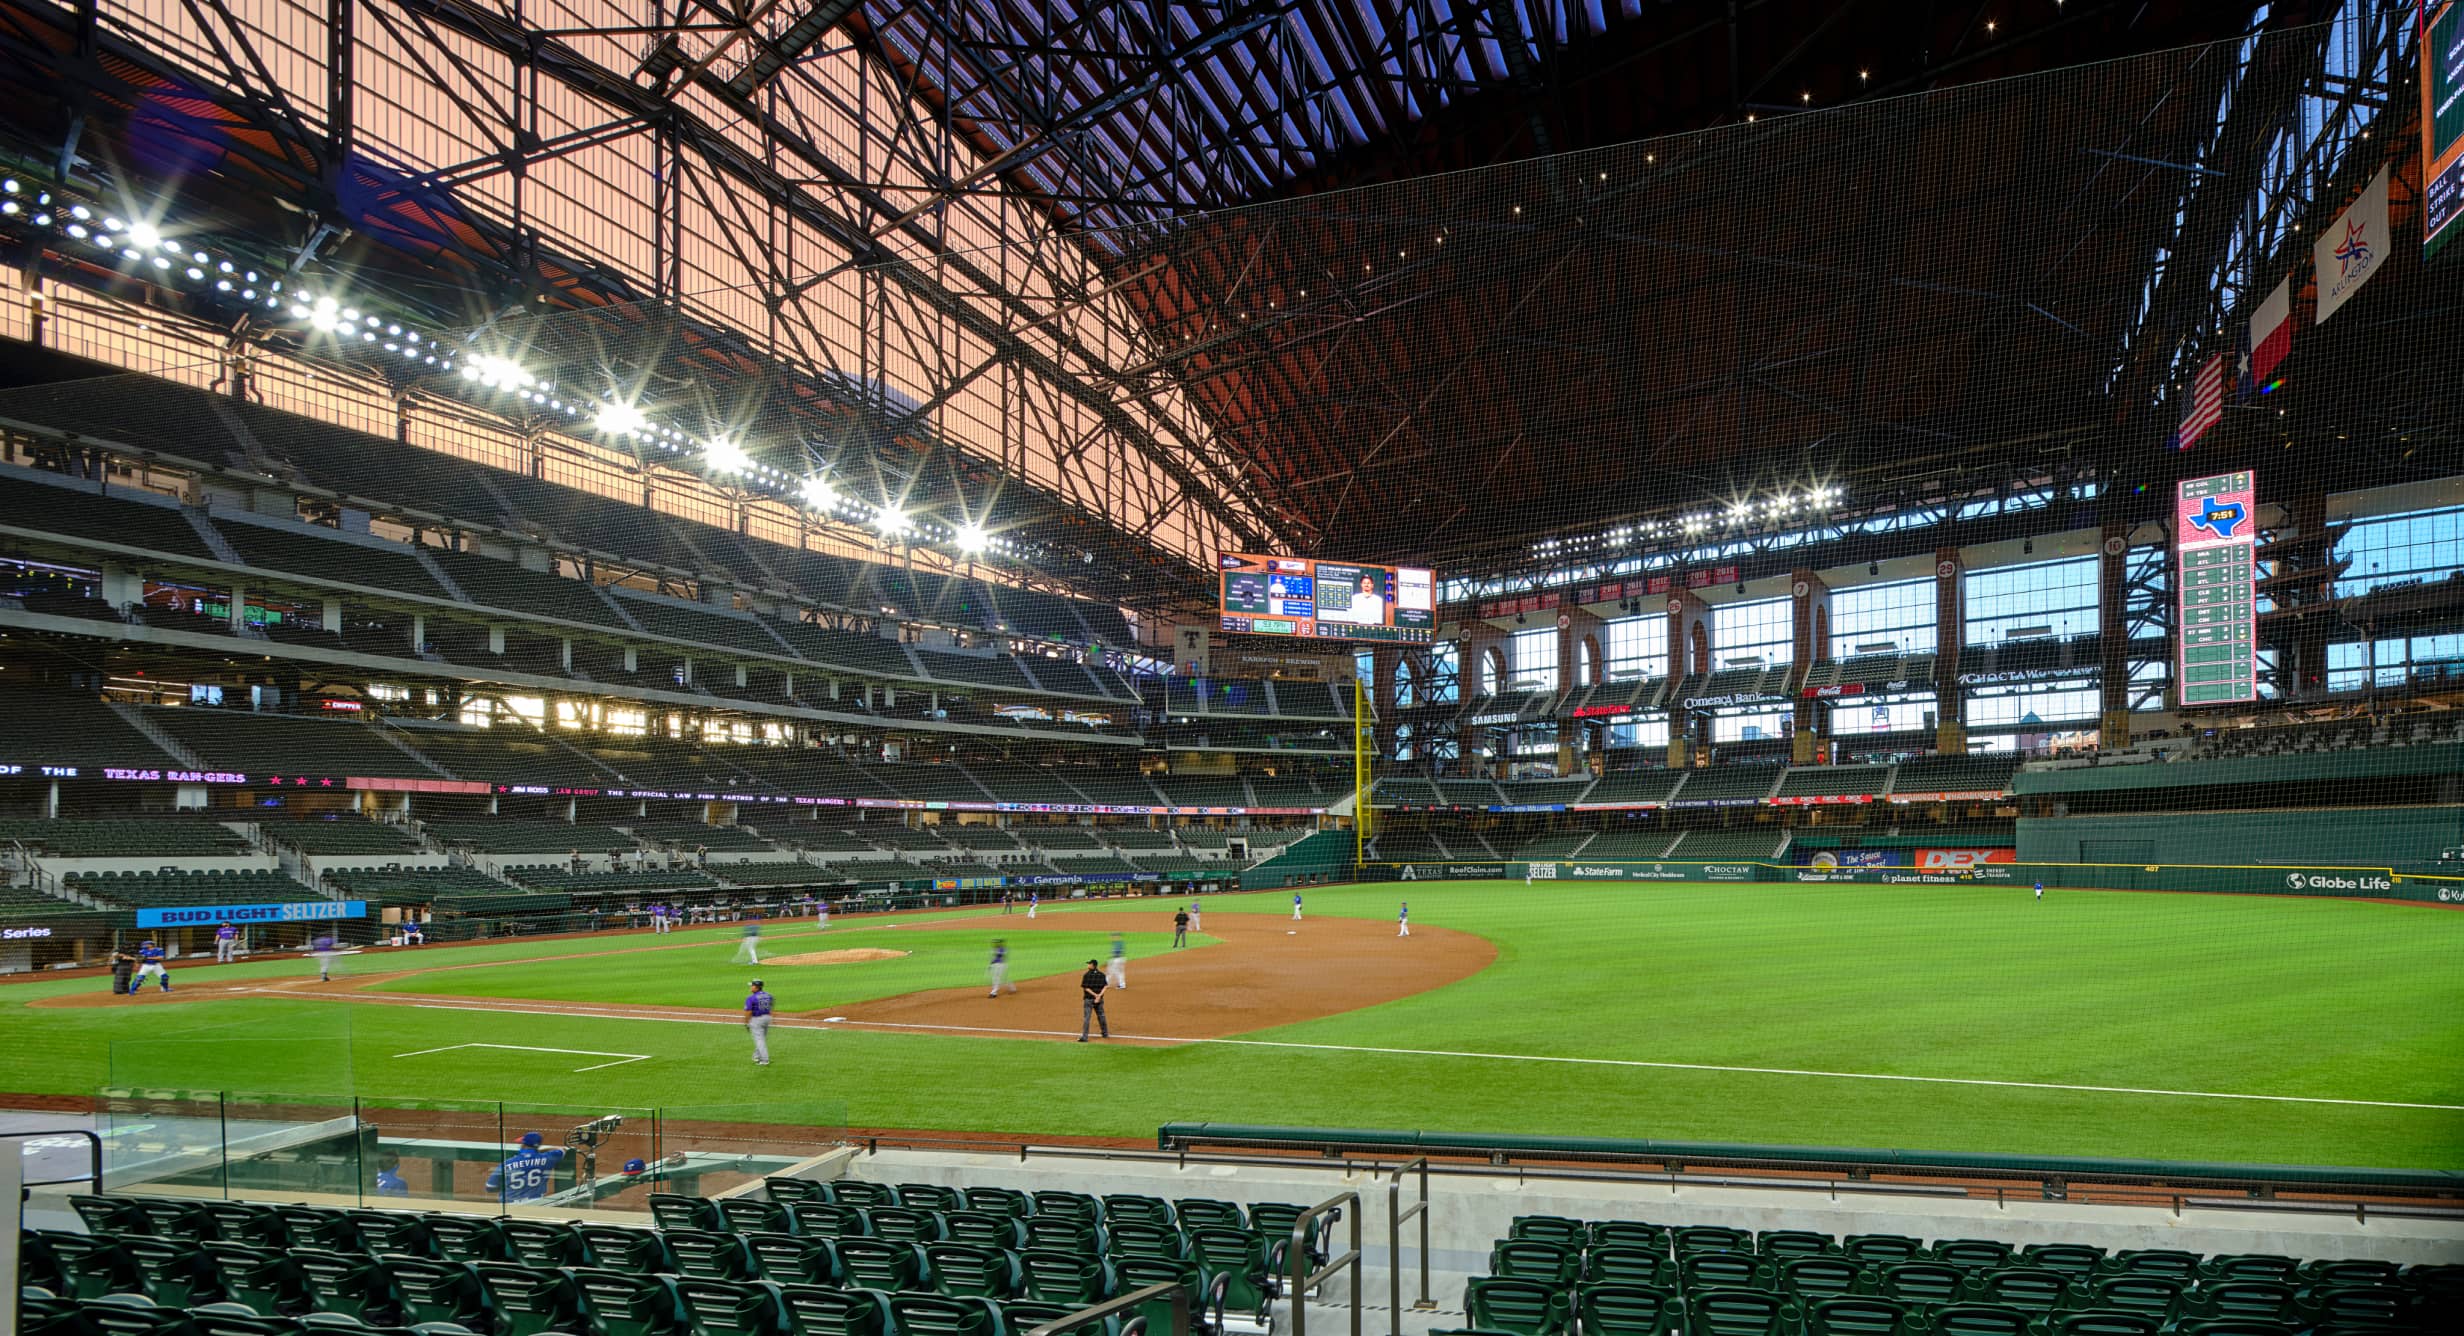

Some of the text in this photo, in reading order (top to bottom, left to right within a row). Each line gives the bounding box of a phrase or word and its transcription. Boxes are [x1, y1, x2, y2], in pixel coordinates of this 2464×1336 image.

[2429, 176, 2447, 198] BALL
[2429, 183, 2456, 213] STRIKE
[2429, 207, 2446, 228] OUT
[2211, 510, 2234, 520] 7:51
[1735, 691, 1764, 703] Bank
[1471, 712, 1517, 726] SAMSUNG
[41, 767, 78, 777] THE
[104, 768, 161, 780] TEXAS
[167, 770, 247, 783] RANGERS
[631, 790, 668, 798] OFFICIAL
[1945, 791, 1998, 800] WHATABURGER
[1846, 851, 1881, 865] The Sauce
[1924, 851, 1994, 868] DEX
[1449, 866, 1503, 874] RoofClaim.com
[1530, 867, 1557, 879] SELTZER
[1708, 865, 1750, 874] CHOCTAW
[1033, 874, 1082, 884] Germania
[1891, 873, 1955, 884] planet fitness
[2309, 875, 2391, 890] Globe Life
[161, 901, 347, 923] BUD LIGHT SELTZER
[2, 926, 52, 939] Series
[506, 1158, 547, 1171] TREVINO
[510, 1168, 542, 1190] 56
